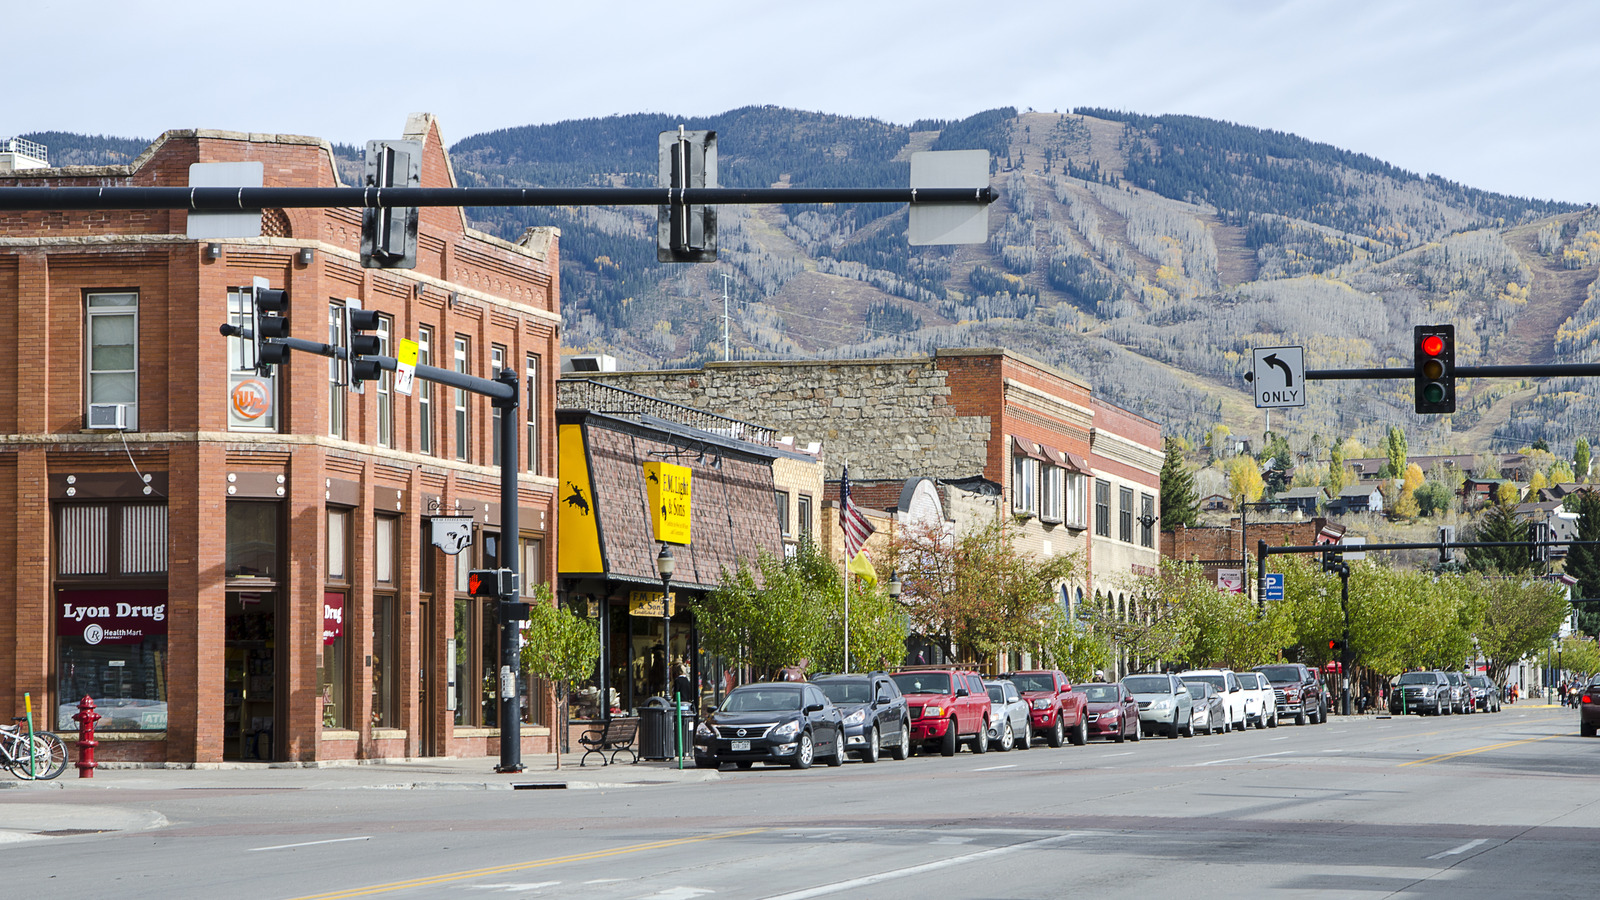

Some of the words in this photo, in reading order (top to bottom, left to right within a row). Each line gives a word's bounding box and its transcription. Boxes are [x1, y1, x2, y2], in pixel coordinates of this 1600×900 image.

[1262, 390, 1298, 403] ONLY
[675, 476, 689, 501] Light
[673, 497, 686, 518] Sons
[63, 603, 110, 622] Lyon
[116, 602, 165, 621] Drug
[324, 604, 342, 624] Drug
